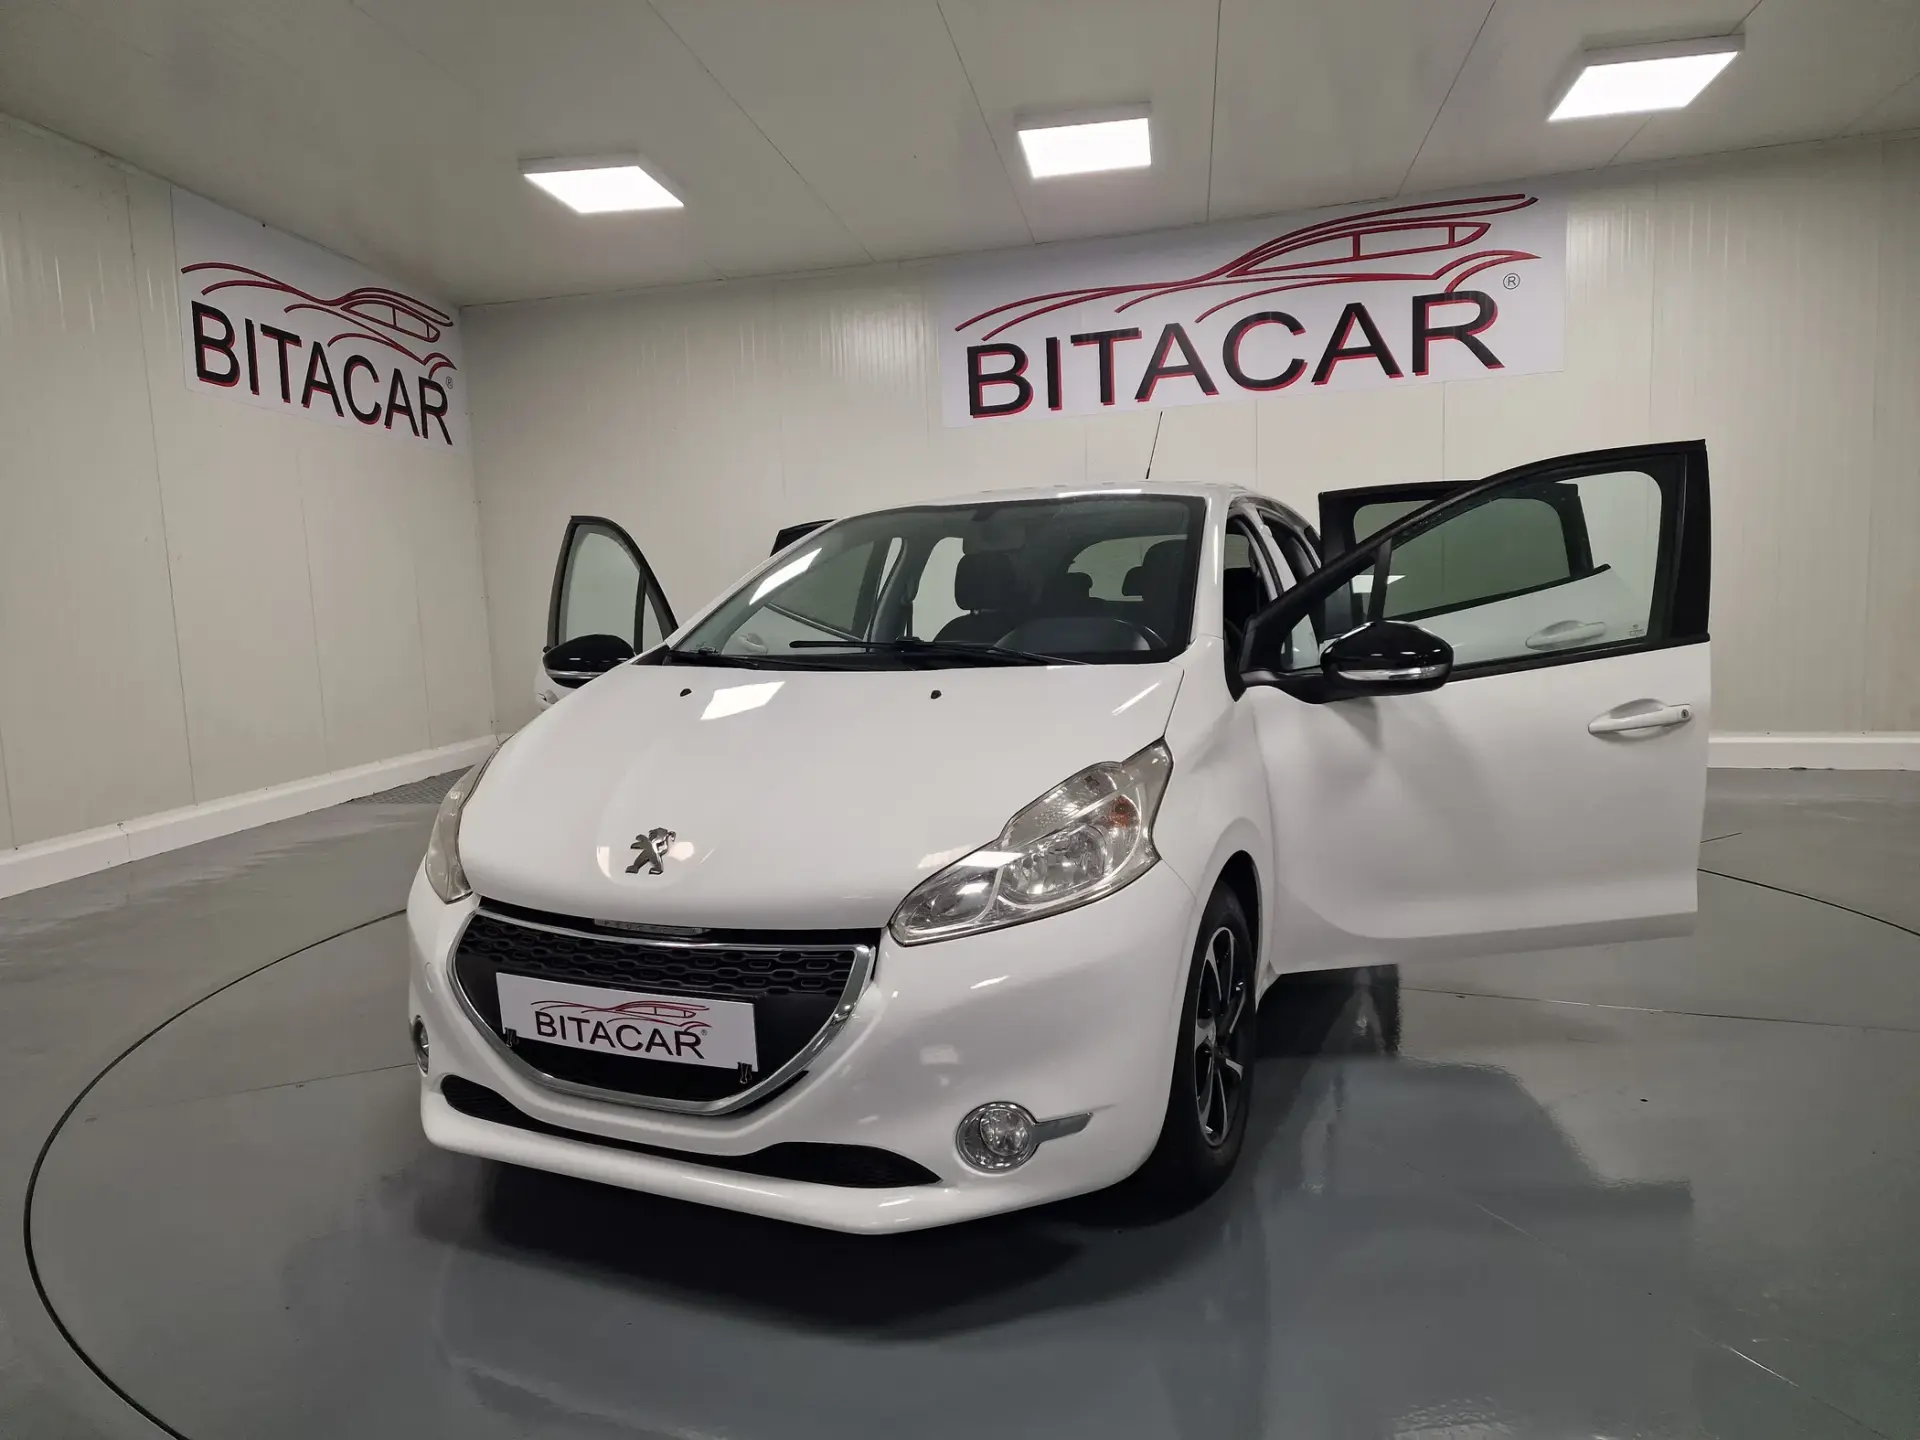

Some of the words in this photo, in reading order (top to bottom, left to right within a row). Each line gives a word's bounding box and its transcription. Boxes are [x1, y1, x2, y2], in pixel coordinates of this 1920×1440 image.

[191, 300, 453, 446] BITACAR
[967, 290, 1505, 419] BITACAR
[534, 1010, 705, 1060] BITACAR
